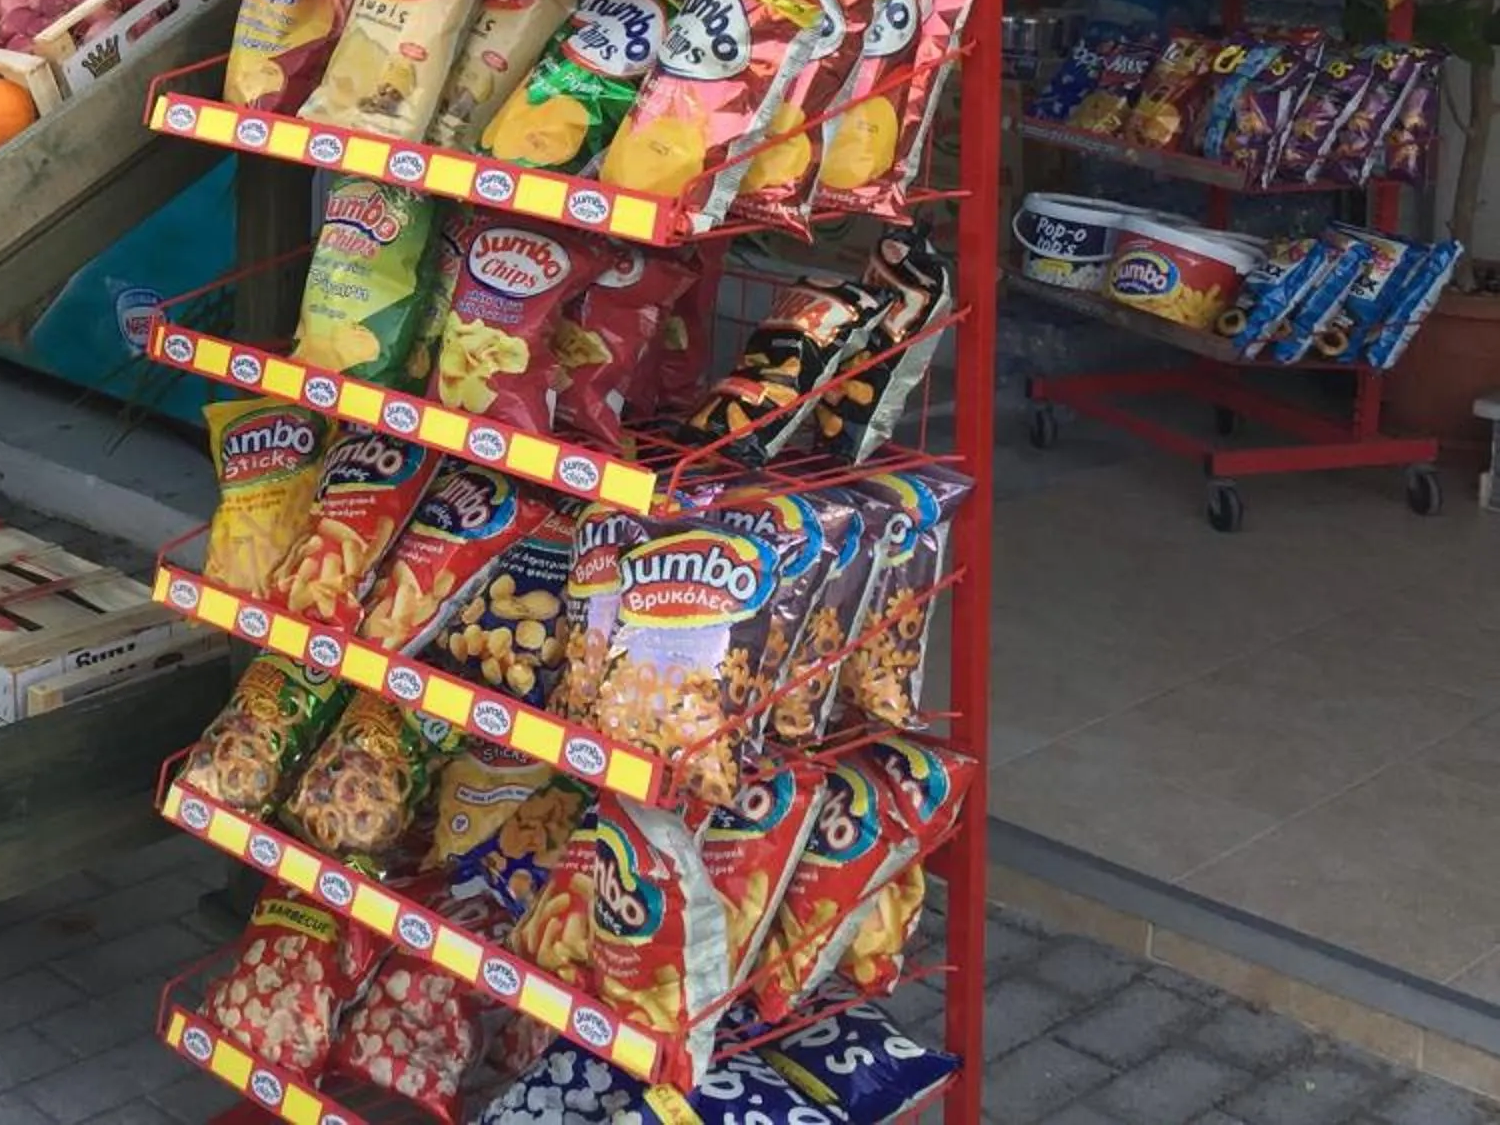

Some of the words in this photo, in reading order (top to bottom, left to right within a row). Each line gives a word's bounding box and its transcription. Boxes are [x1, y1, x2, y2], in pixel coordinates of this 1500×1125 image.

[324, 192, 401, 242] umbo
[475, 232, 561, 280] Jumbo
[480, 257, 538, 289] Chips
[620, 546, 757, 601] Jumbo
[267, 901, 330, 935] BARBECUE
